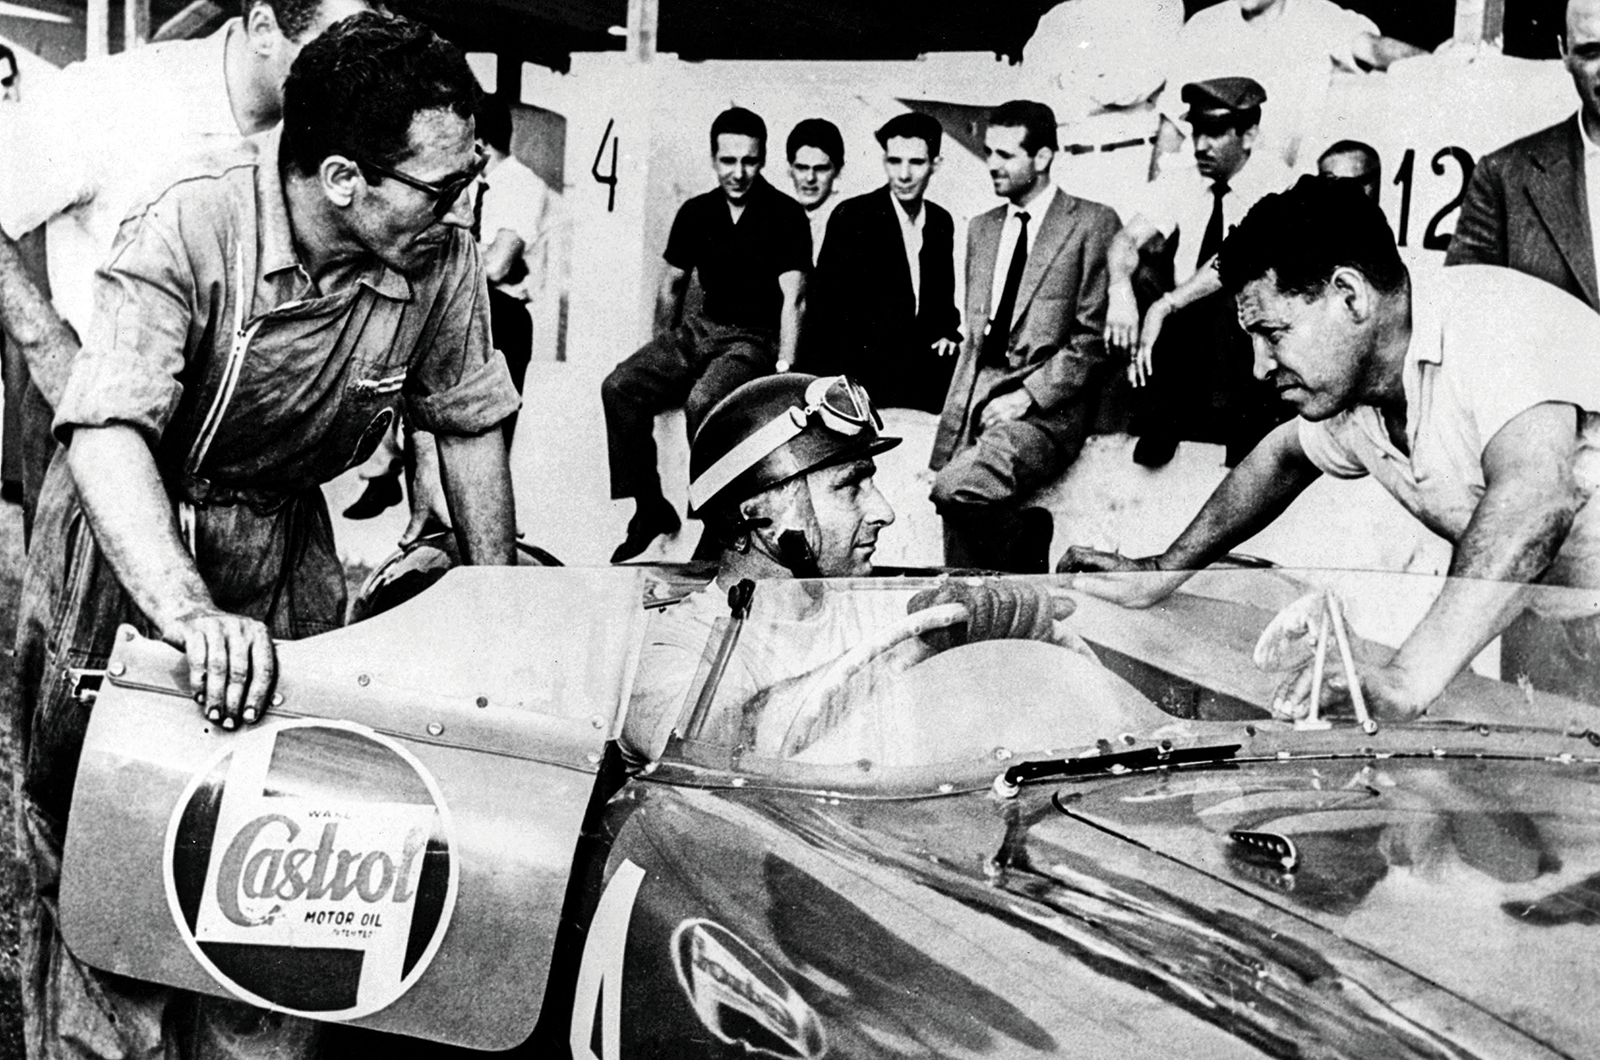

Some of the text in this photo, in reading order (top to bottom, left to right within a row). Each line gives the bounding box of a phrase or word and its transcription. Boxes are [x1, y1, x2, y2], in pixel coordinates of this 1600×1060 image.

[591, 118, 618, 212] 4
[1393, 146, 1476, 251] 12
[216, 813, 423, 927] Castrol
[304, 910, 382, 927] MOTOR OIL
